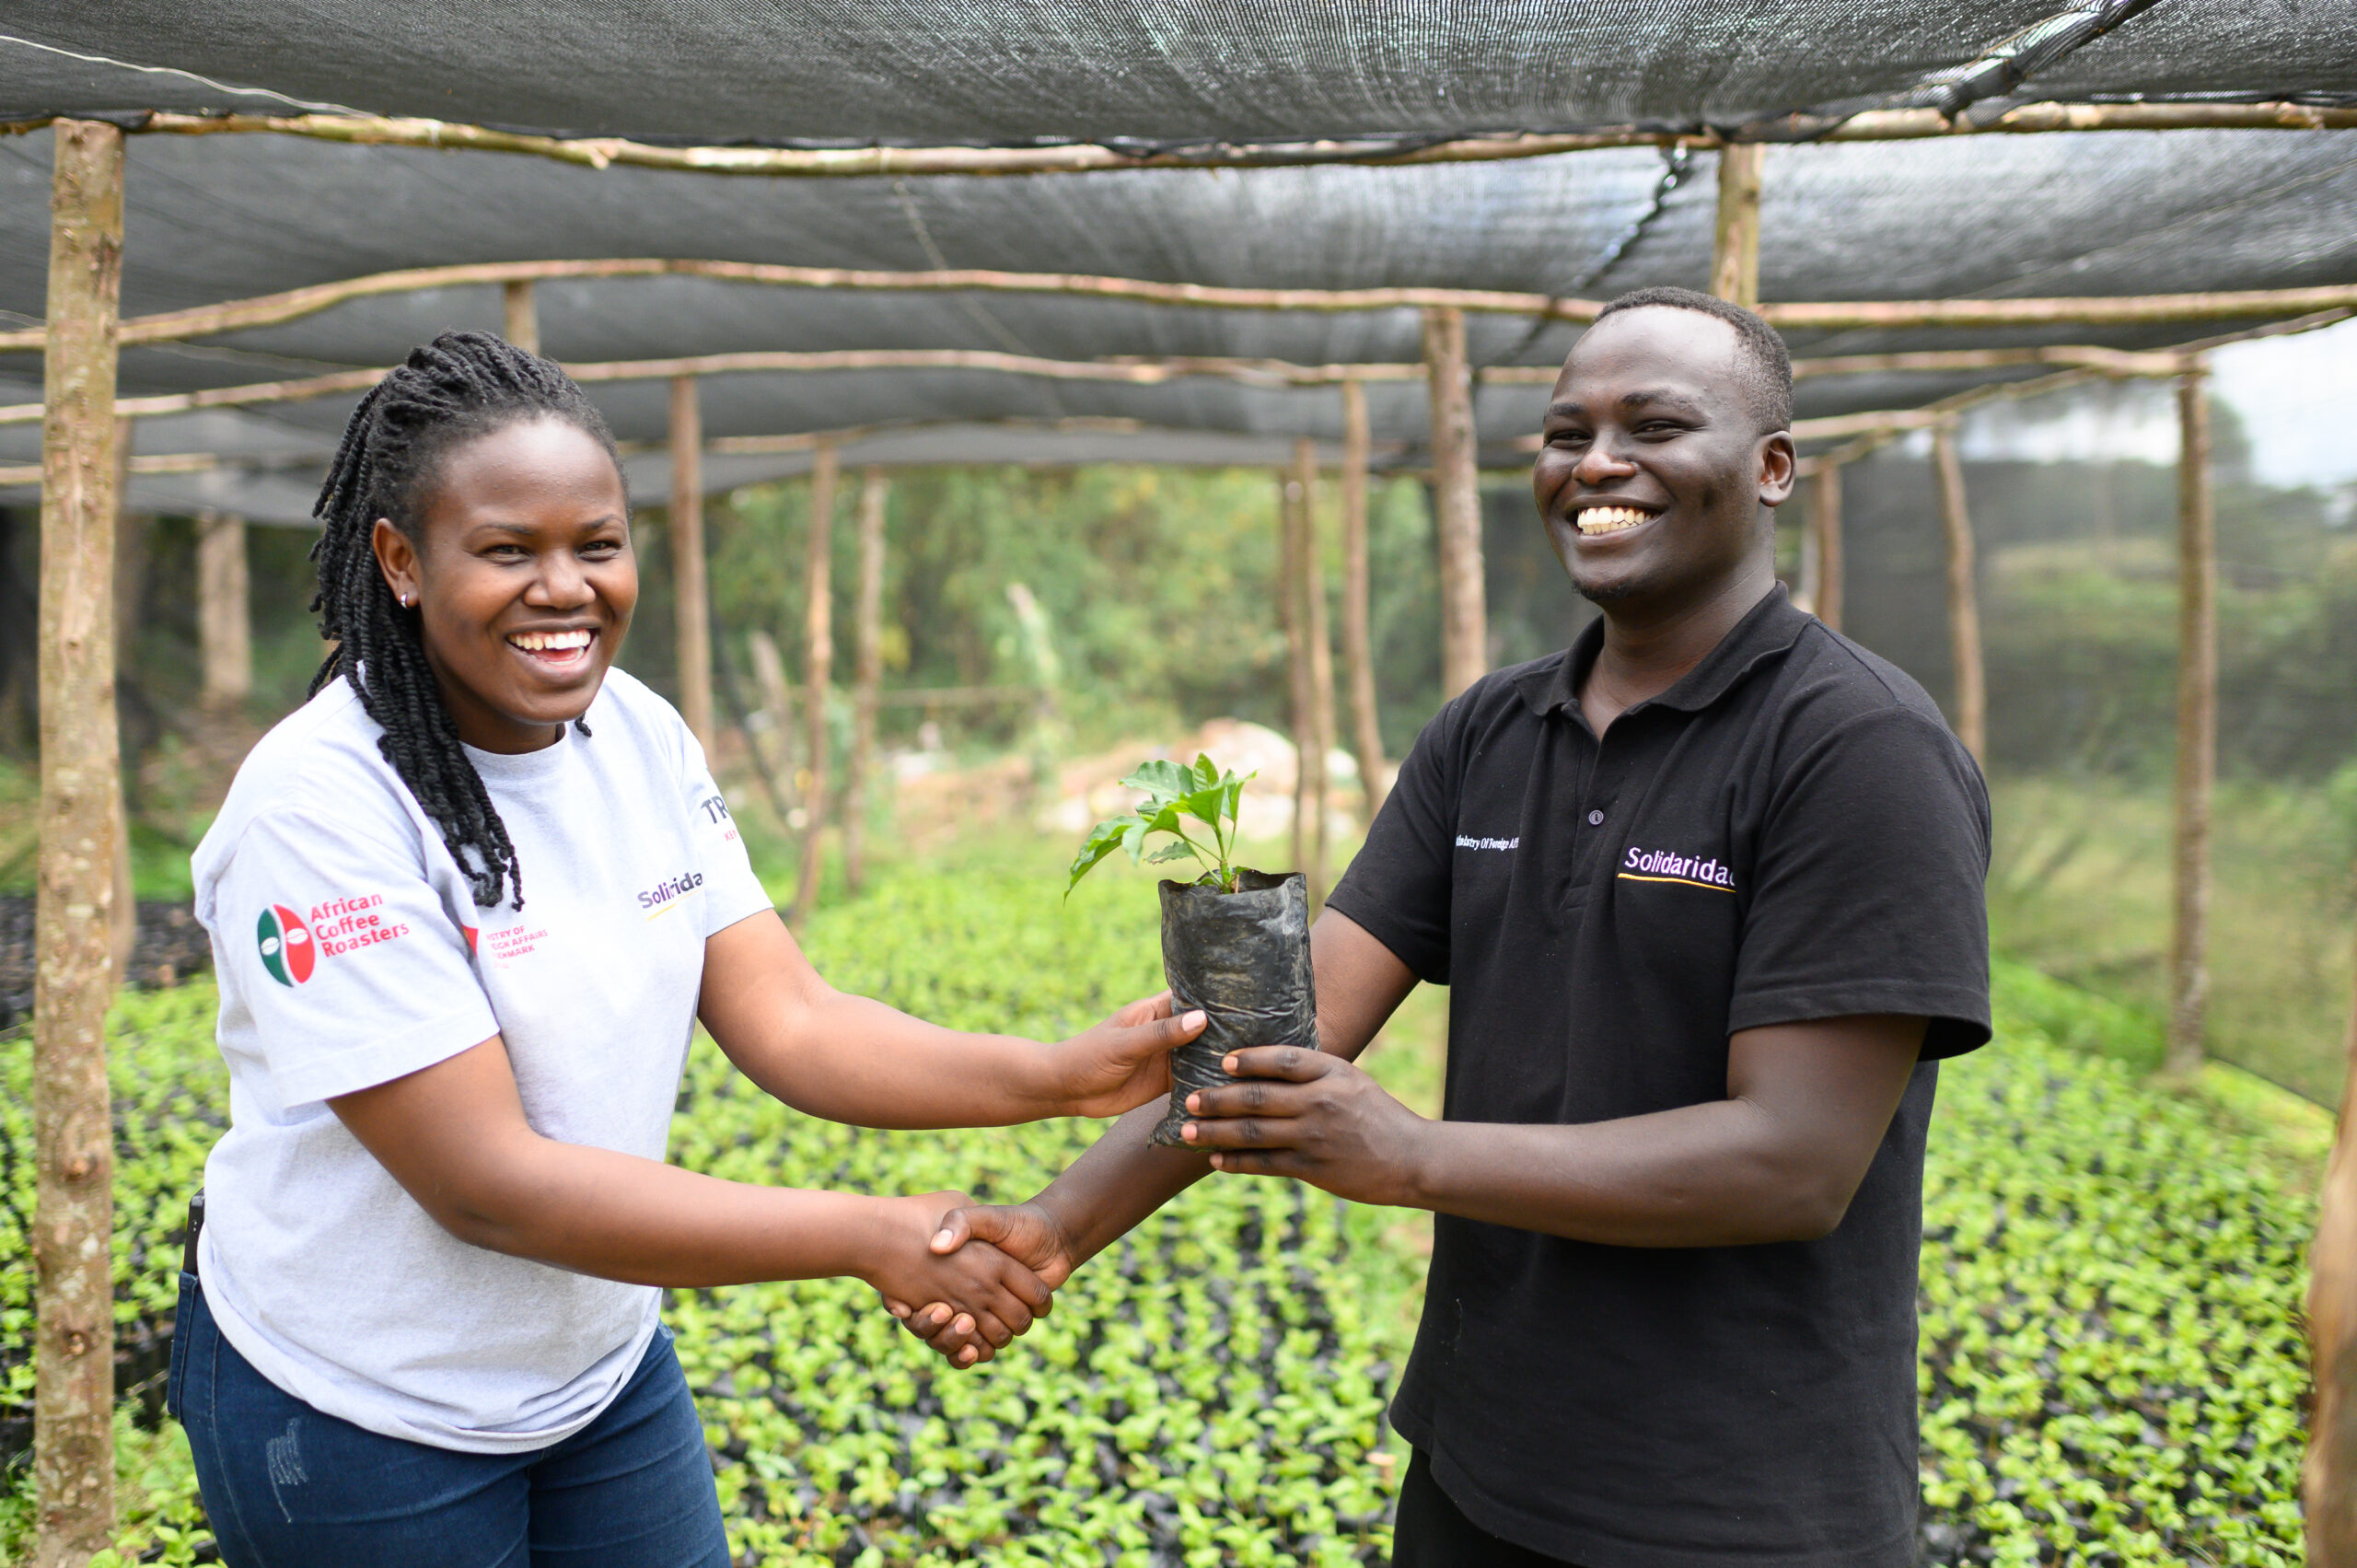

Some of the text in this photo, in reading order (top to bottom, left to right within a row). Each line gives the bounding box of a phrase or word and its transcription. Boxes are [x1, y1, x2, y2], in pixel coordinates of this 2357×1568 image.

[311, 894, 383, 923] African
[316, 914, 380, 940] Coffee
[512, 929, 548, 946] AFFAIRS
[513, 925, 525, 935] OF
[321, 923, 410, 958] Roasters
[493, 945, 535, 959] ENMARK
